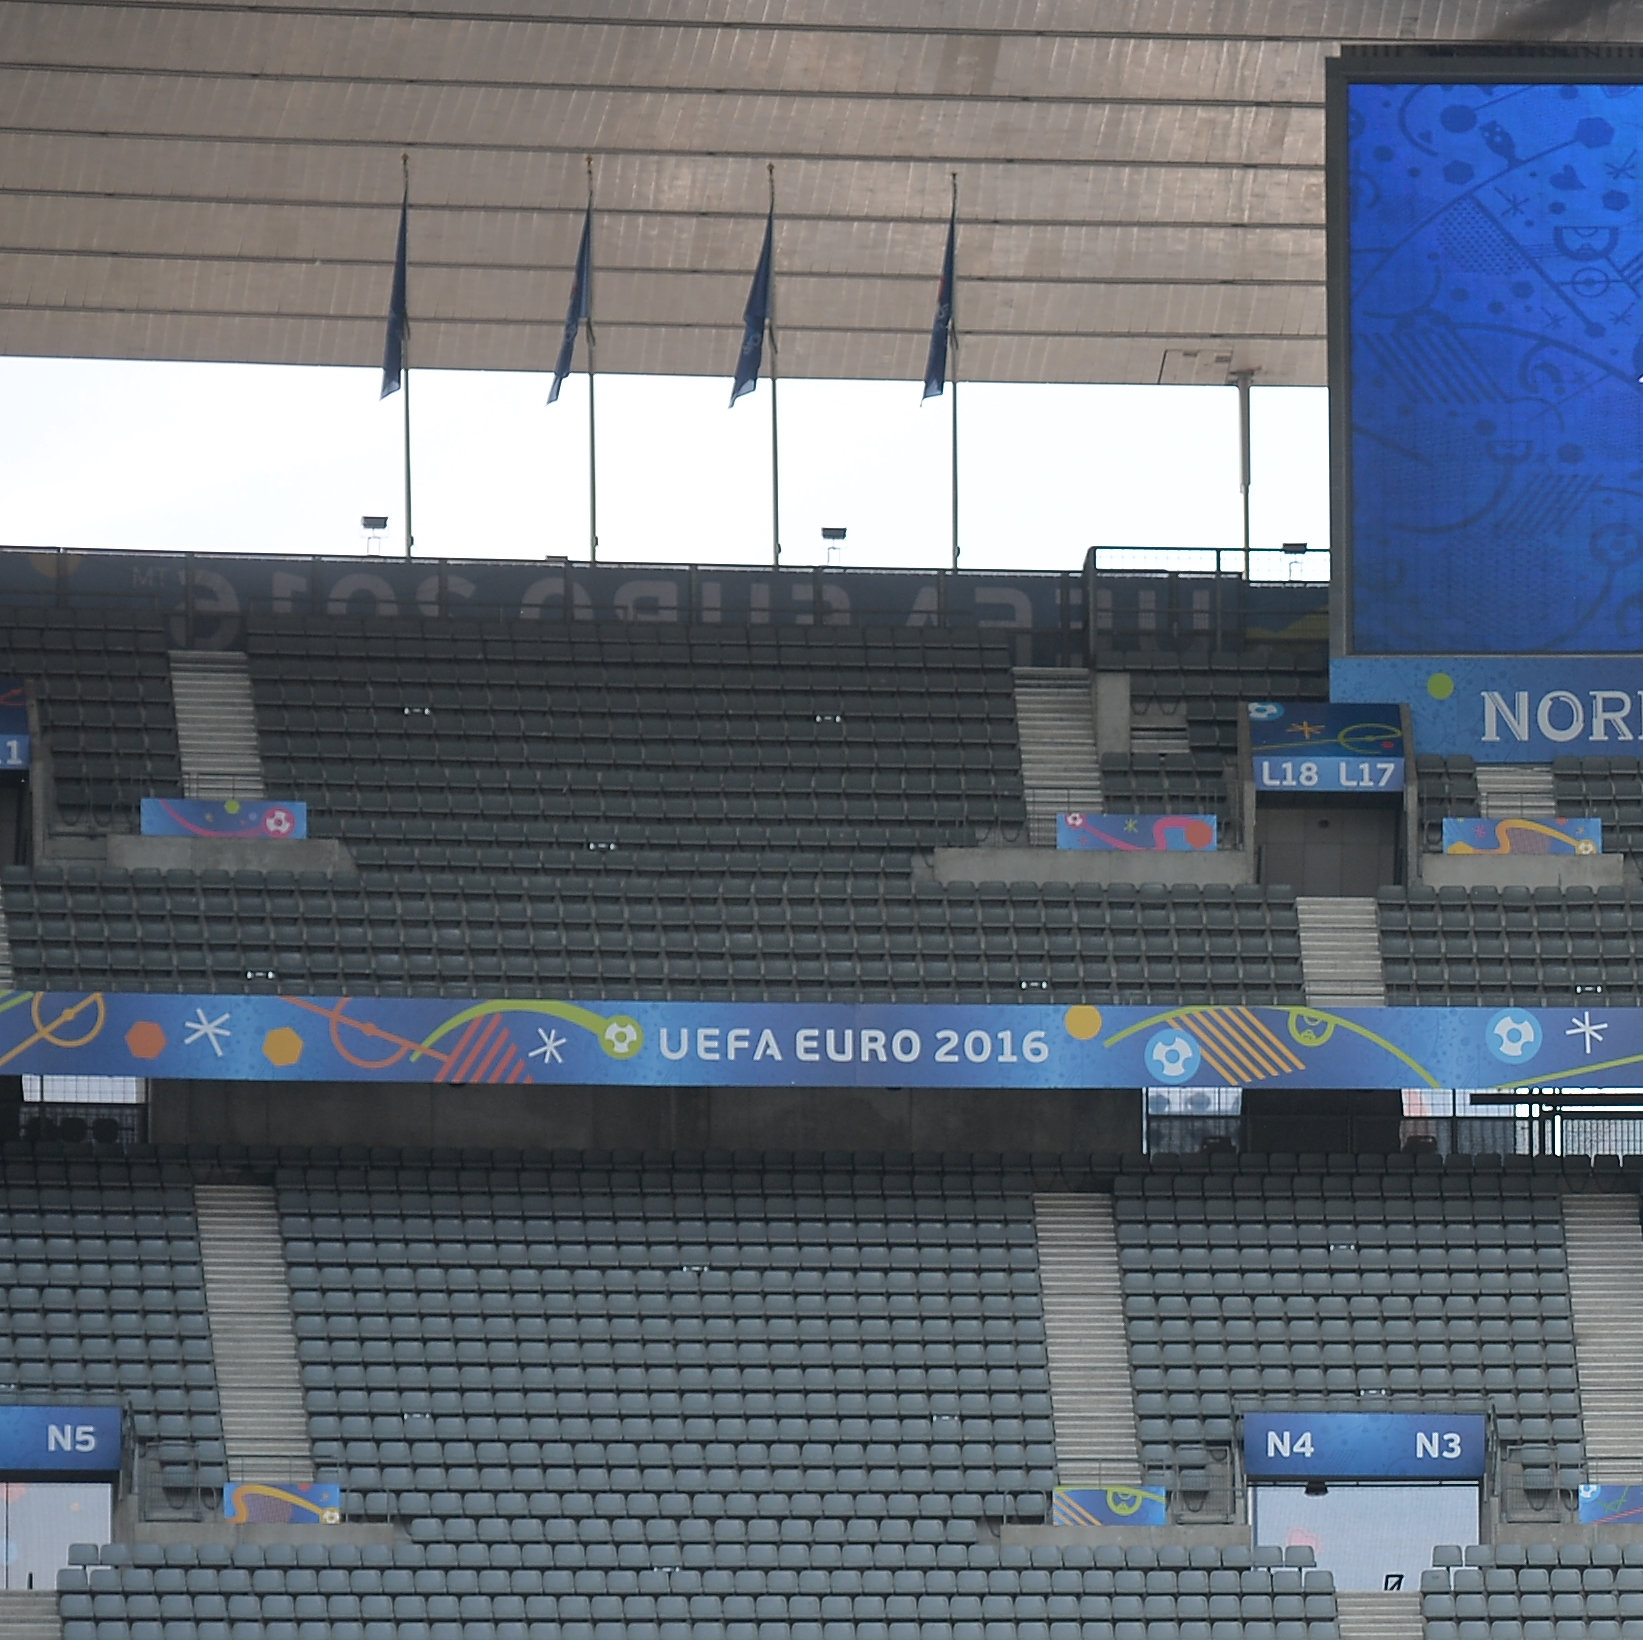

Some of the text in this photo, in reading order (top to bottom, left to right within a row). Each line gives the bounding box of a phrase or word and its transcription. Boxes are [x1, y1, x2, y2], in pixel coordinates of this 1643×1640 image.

[1263, 762, 1394, 786] L18 L17
[660, 1028, 1048, 1062] UEFA EURO 2016
[49, 1425, 95, 1451] N5
[1268, 1431, 1461, 1458] N4 N3
